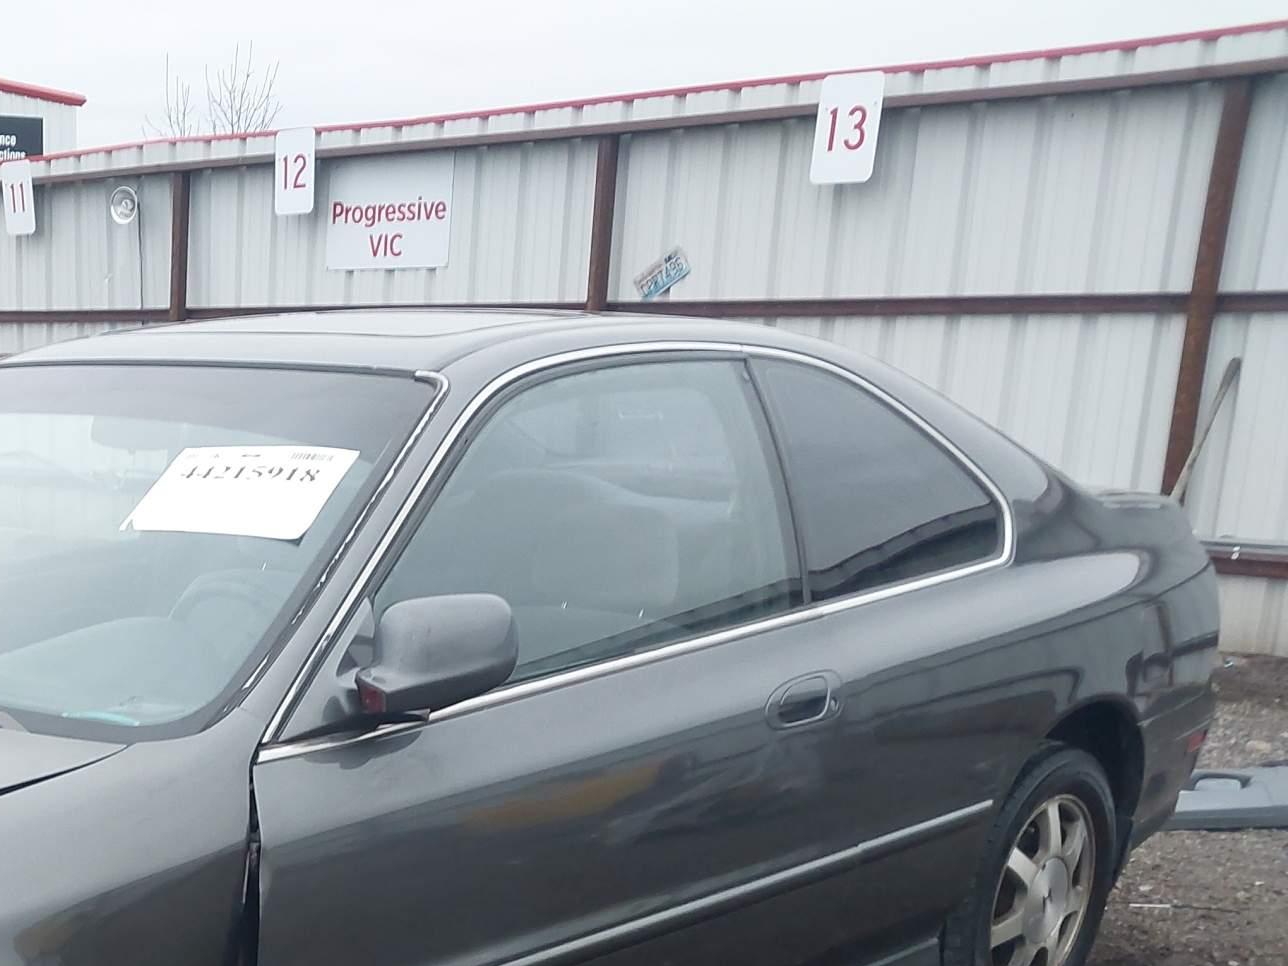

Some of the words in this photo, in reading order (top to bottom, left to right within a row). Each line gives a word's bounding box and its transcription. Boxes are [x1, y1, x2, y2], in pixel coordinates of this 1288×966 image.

[824, 105, 867, 152] 13
[283, 153, 307, 190] 12
[10, 181, 25, 214] 11
[332, 196, 448, 228] Progressive
[369, 233, 404, 258] VIC
